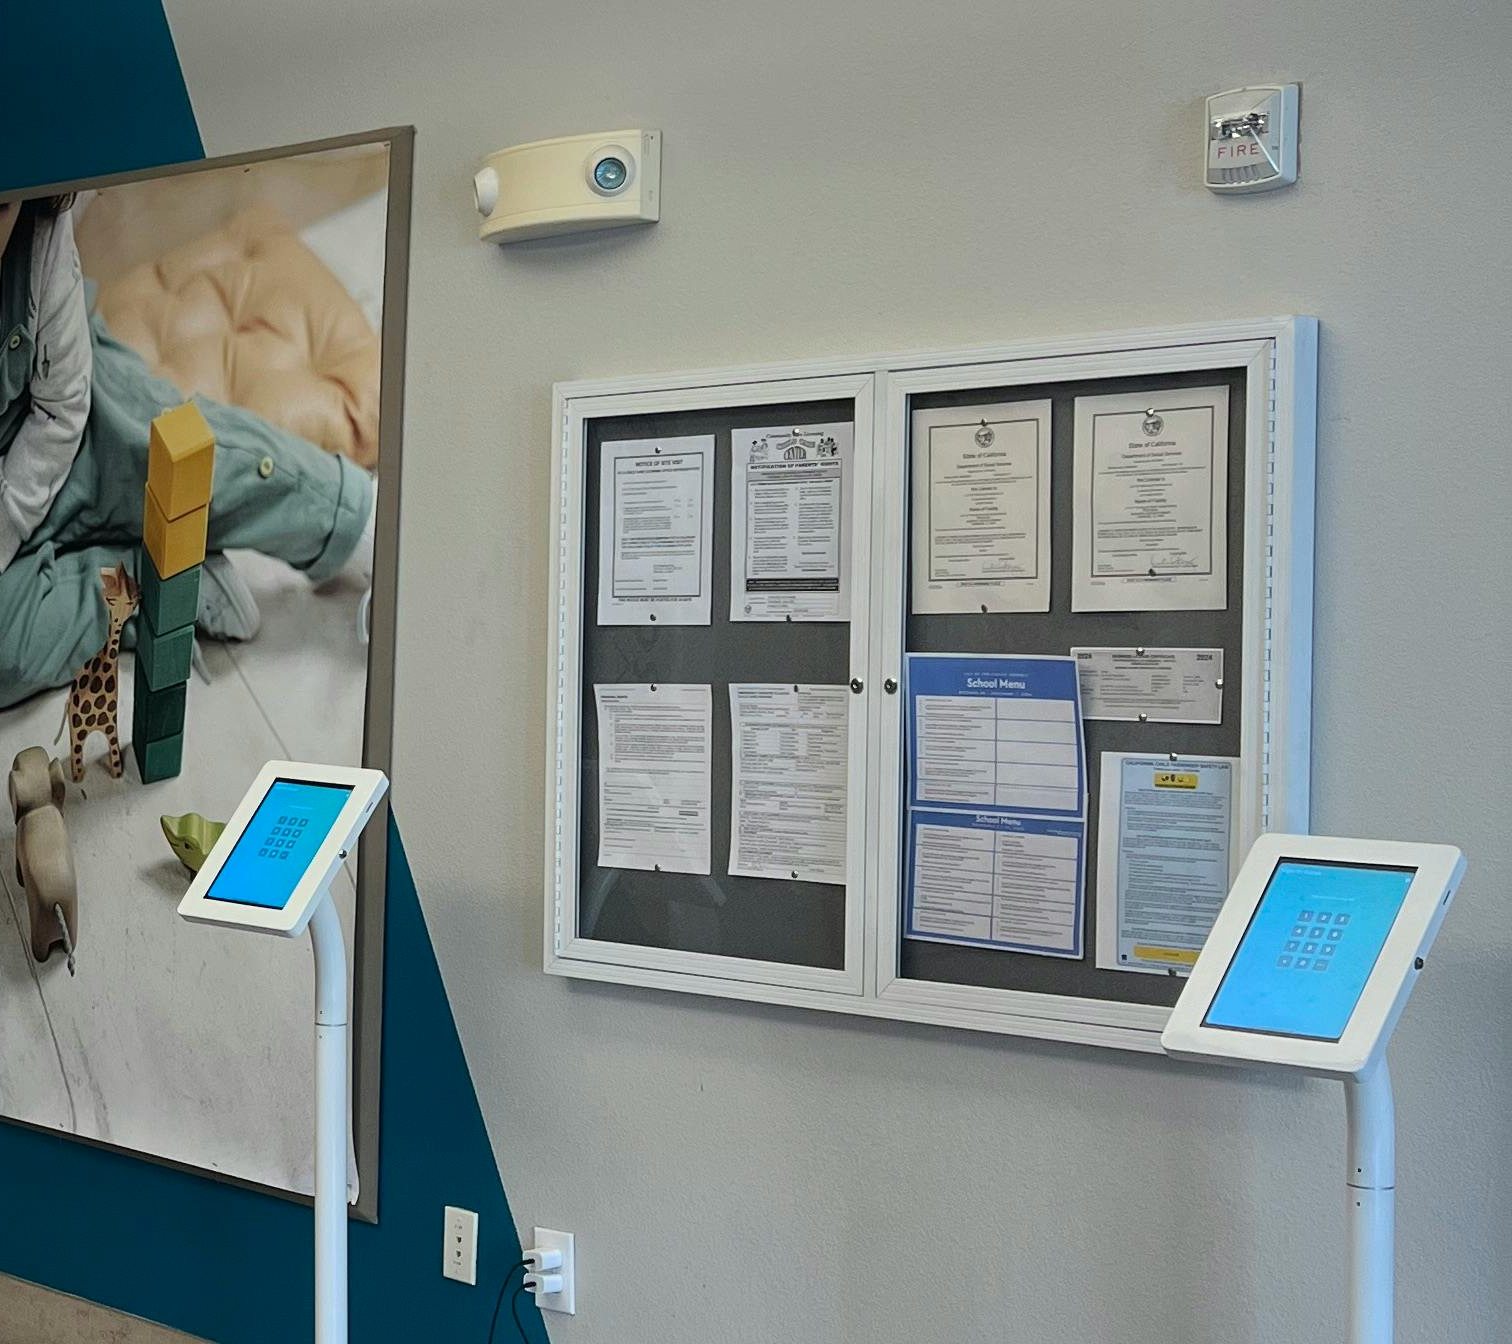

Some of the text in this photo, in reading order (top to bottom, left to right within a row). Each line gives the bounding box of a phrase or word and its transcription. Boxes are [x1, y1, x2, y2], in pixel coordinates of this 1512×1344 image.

[1217, 143, 1260, 159] FIRE
[967, 677, 1026, 690] School Menu
[975, 814, 999, 824] School
[1000, 817, 1022, 826] Menu
